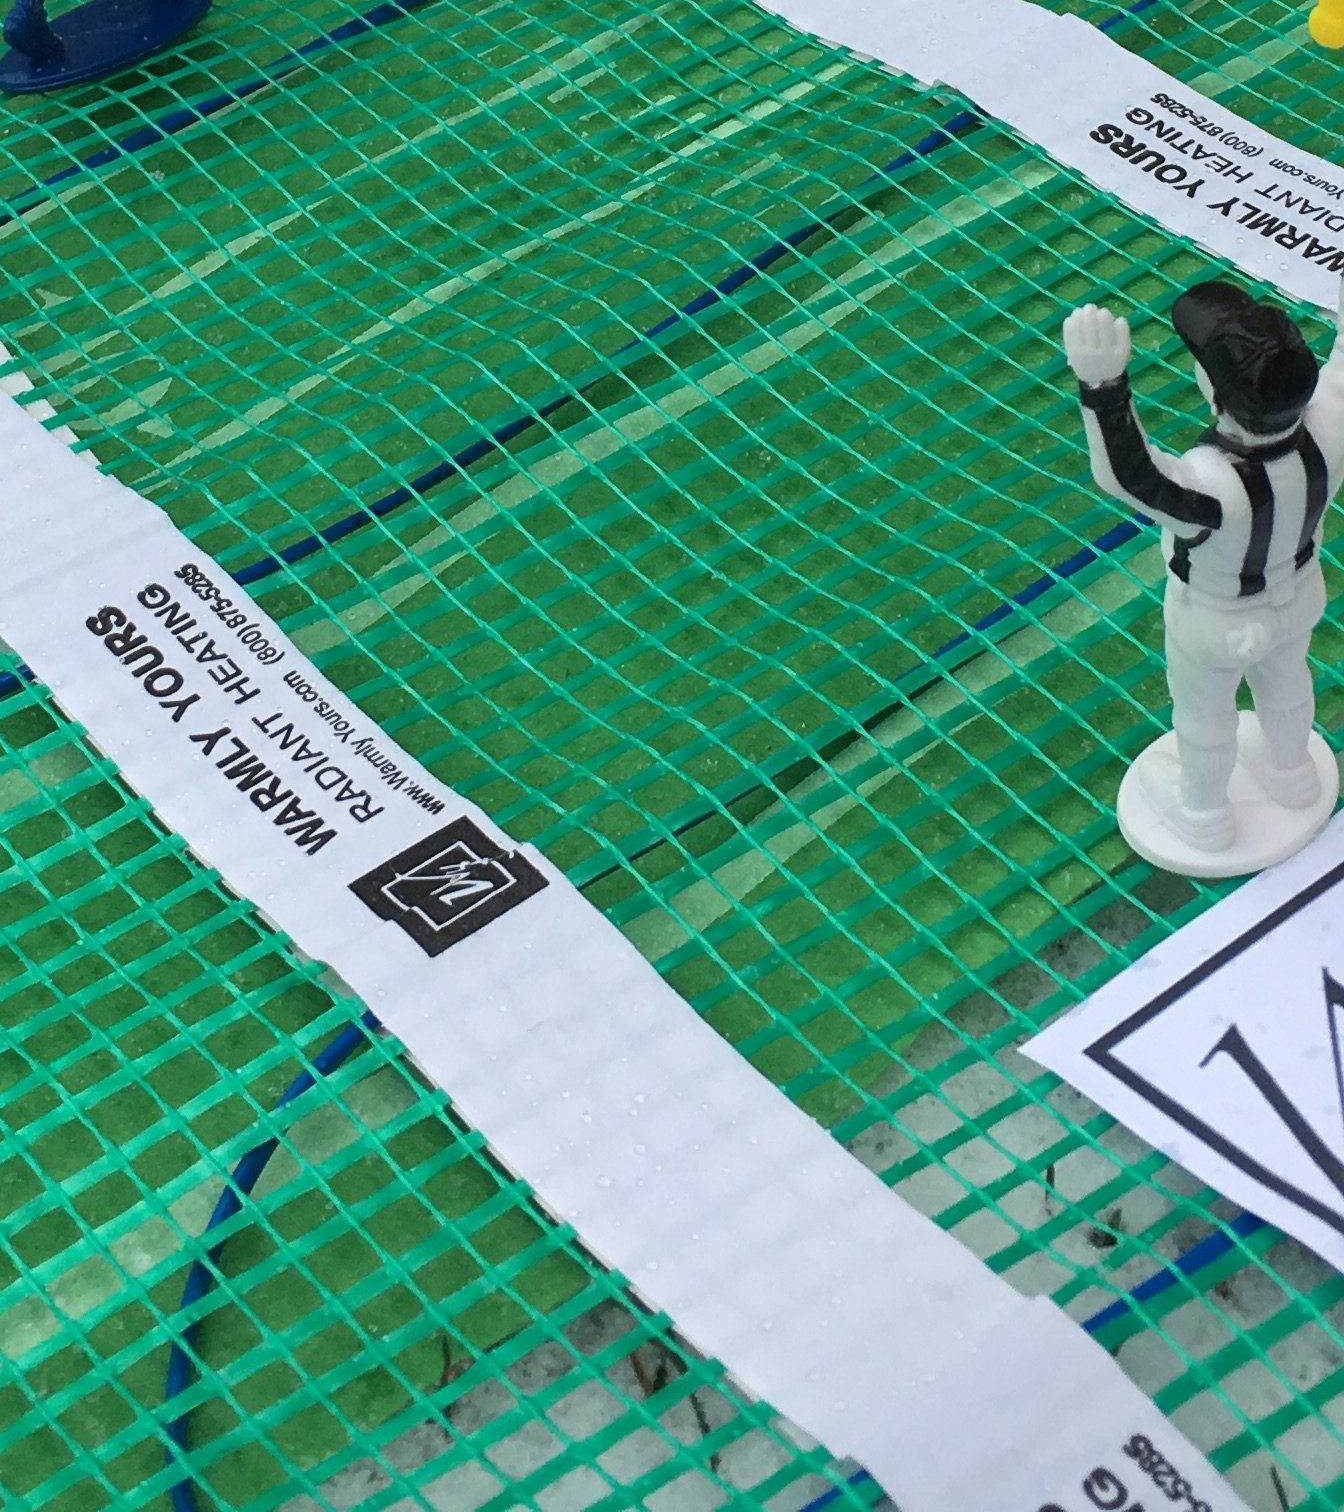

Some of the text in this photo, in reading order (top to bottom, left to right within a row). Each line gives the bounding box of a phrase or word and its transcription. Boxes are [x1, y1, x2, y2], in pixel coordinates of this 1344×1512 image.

[1090, 124, 1341, 272] WARMLY YOURS
[1126, 108, 1254, 183] HEATING
[86, 606, 337, 856] WARMLY YOURS
[137, 583, 384, 823] RADIANT HEATING
